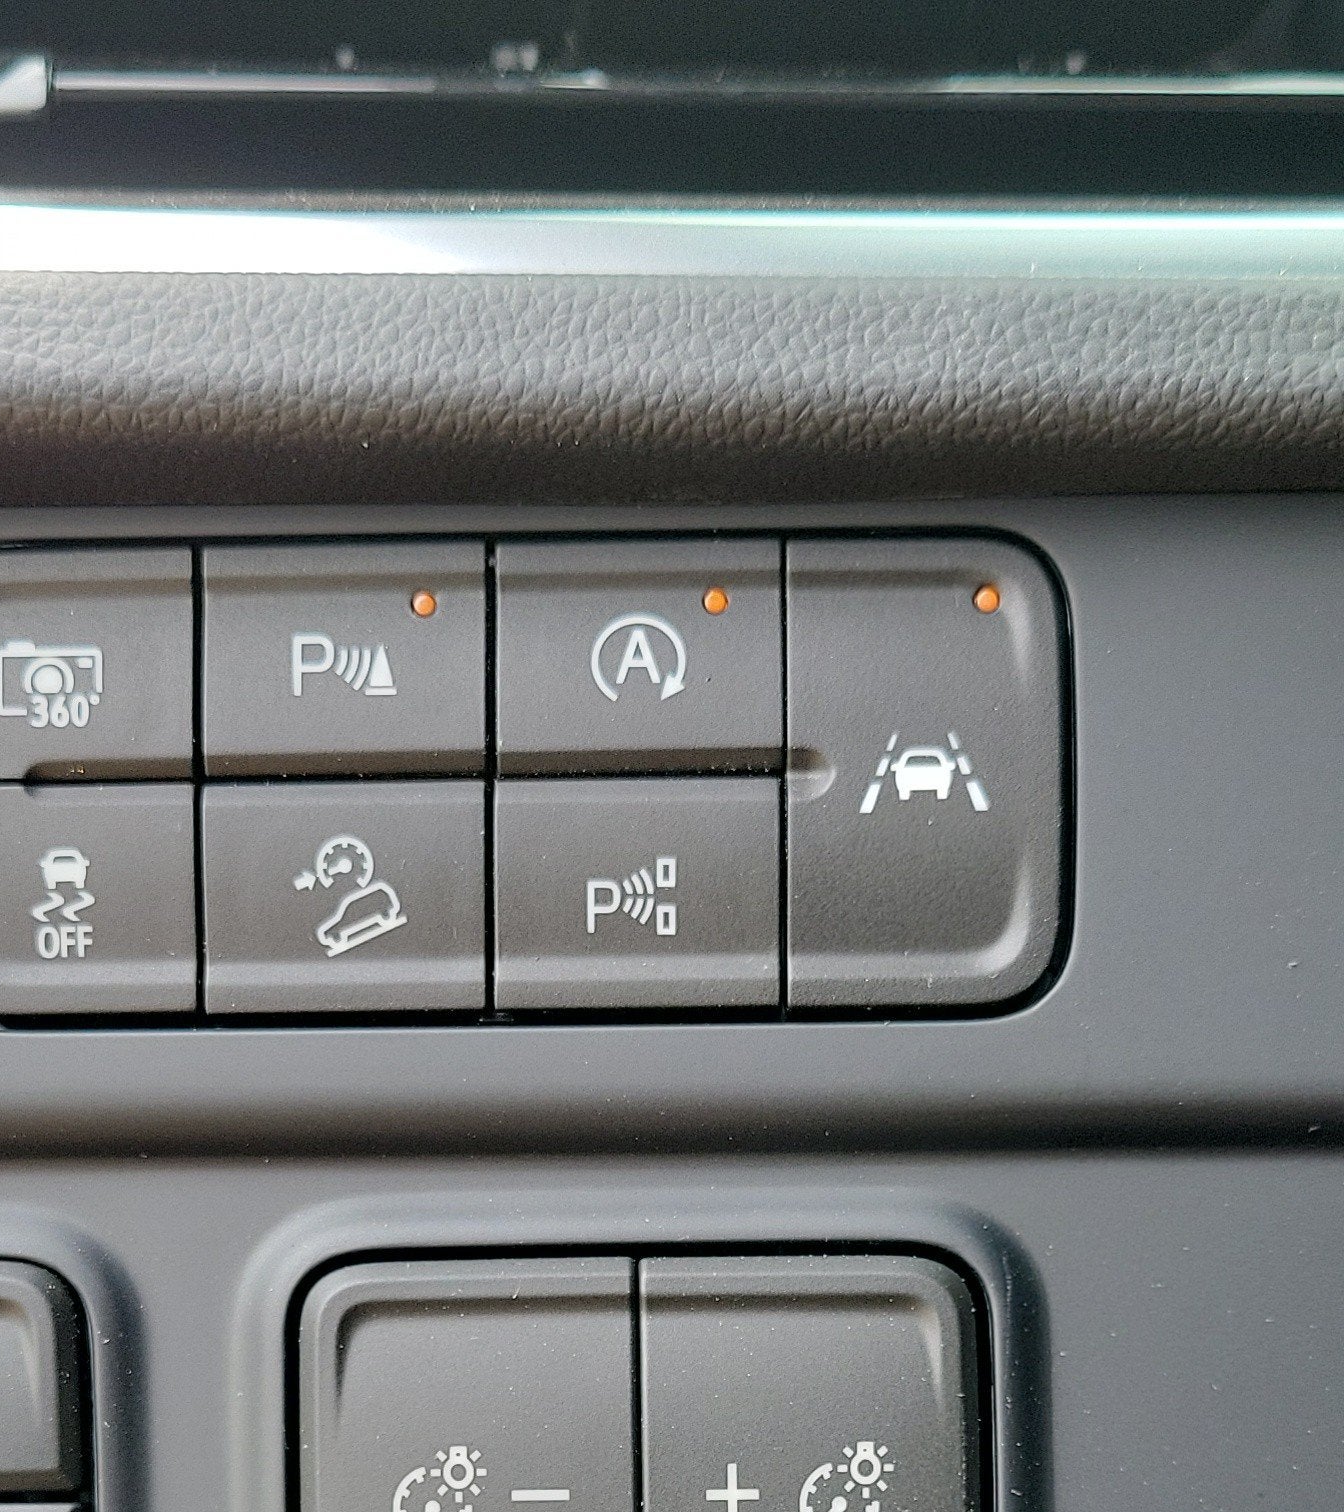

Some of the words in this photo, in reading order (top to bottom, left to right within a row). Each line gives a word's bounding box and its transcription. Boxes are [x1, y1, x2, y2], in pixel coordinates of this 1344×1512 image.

[291, 632, 334, 697] P
[586, 880, 621, 933] P
[37, 924, 94, 959] OFF
